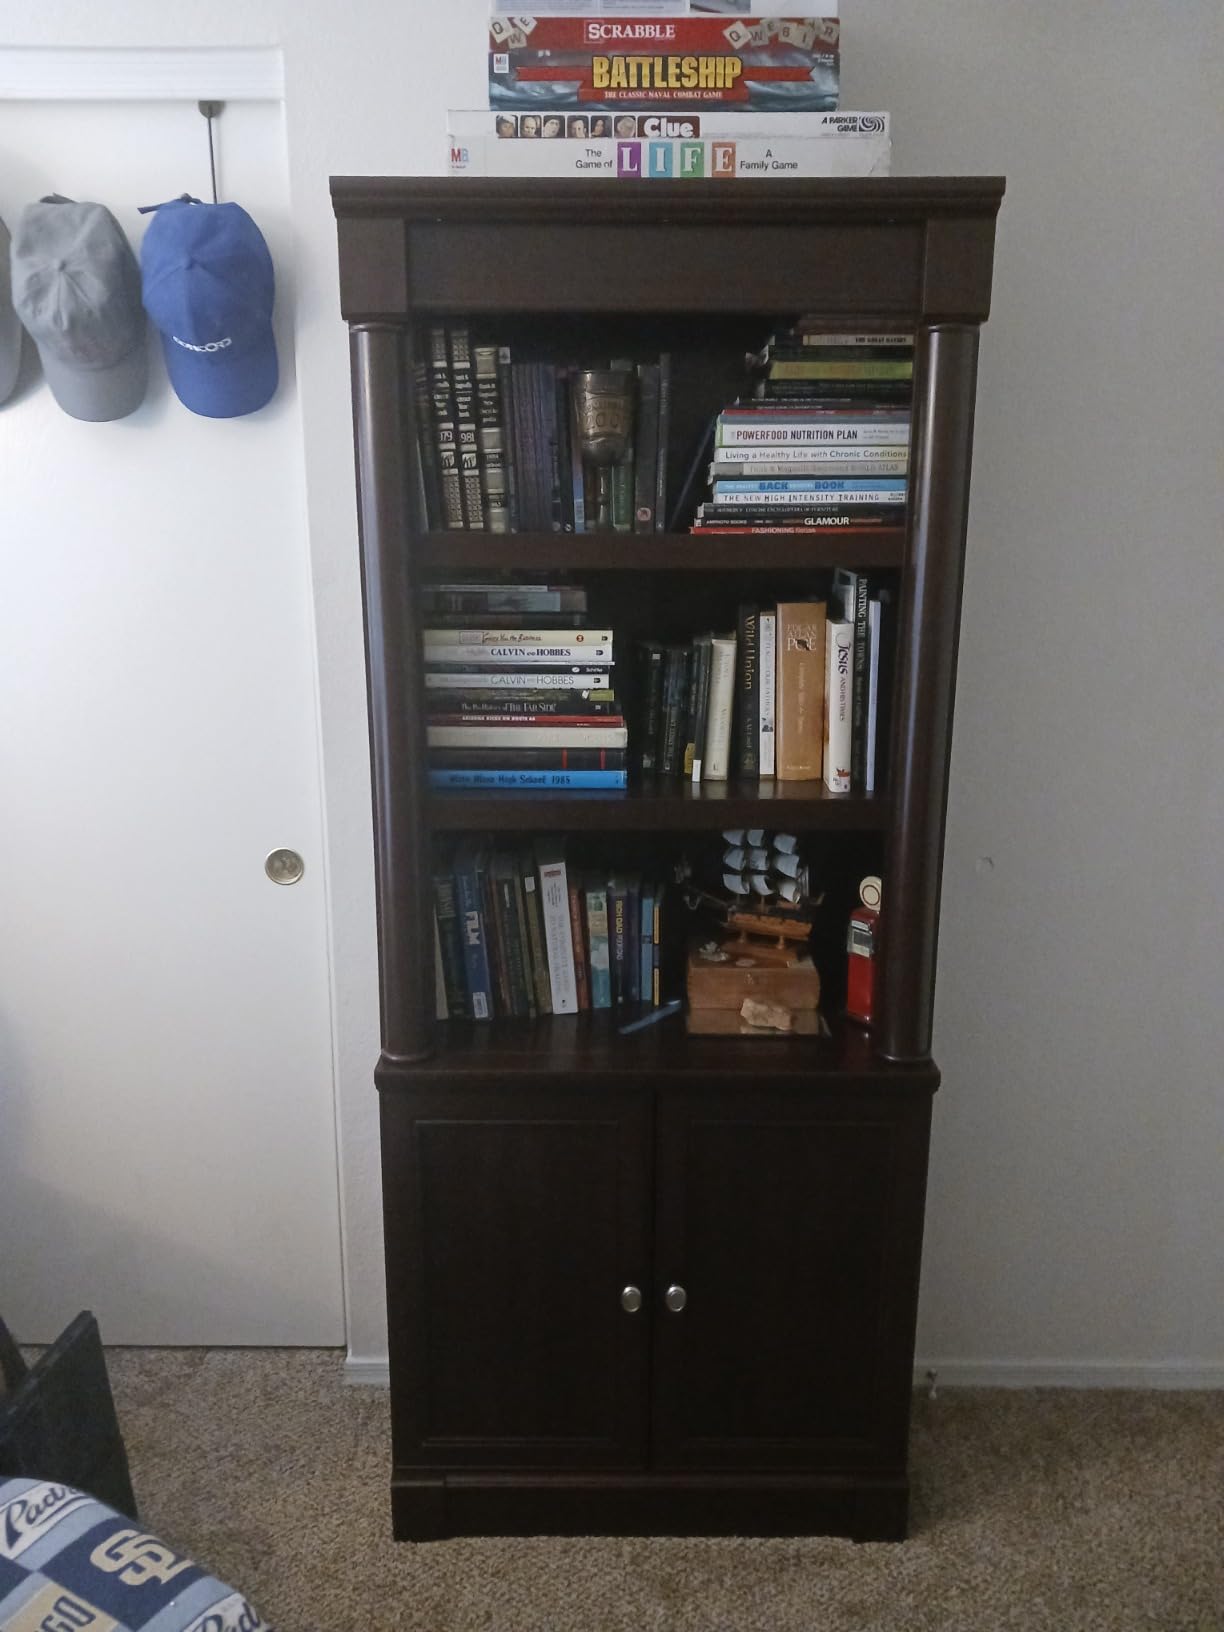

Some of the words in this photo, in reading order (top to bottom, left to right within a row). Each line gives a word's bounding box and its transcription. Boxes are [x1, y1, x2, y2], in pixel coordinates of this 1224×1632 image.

[588, 23, 676, 39] SCRABBLE
[728, 30, 740, 43] Q
[592, 54, 743, 89] BATTLESHIP
[604, 91, 617, 99] THE
[618, 91, 647, 99] CLASSIC
[648, 91, 671, 99] NAVAL
[673, 91, 701, 99] COMBAT
[703, 91, 723, 99] GAME
[821, 116, 828, 124] A
[829, 116, 858, 124] PARKER
[643, 117, 694, 138] Clue
[837, 124, 858, 132] GAME
[451, 148, 470, 162] MB
[585, 148, 602, 158] The
[765, 149, 773, 158] A
[575, 160, 602, 169] Game
[603, 159, 613, 169] of
[620, 147, 734, 173] LIFE
[740, 160, 769, 171] Family
[771, 160, 798, 170] Game
[736, 430, 788, 440] POWERFOOD
[790, 430, 834, 440] NUTRITION
[836, 430, 858, 439] PLAN
[725, 451, 750, 461] Living
[759, 450, 790, 460] Healthy
[793, 450, 808, 458] Life
[810, 450, 828, 458] with
[829, 449, 860, 458] Chronic
[863, 448, 908, 458] Conditions
[759, 482, 789, 491] BACK
[814, 481, 845, 490] BOOK
[724, 494, 739, 502] THE
[744, 494, 762, 502] NEW
[764, 494, 785, 502] HIGH
[788, 493, 834, 503] INTENSITY
[838, 493, 880, 502] TRAINING
[804, 516, 850, 525] GLAMOUR
[857, 577, 868, 618] PAINTING
[743, 615, 756, 647] Wild
[856, 620, 866, 638] THE
[490, 648, 526, 656] CALVIN
[536, 648, 572, 656] HOBBES
[490, 675, 526, 685] CALVIN
[536, 675, 575, 685] HOBBES
[551, 774, 571, 784] 1985
